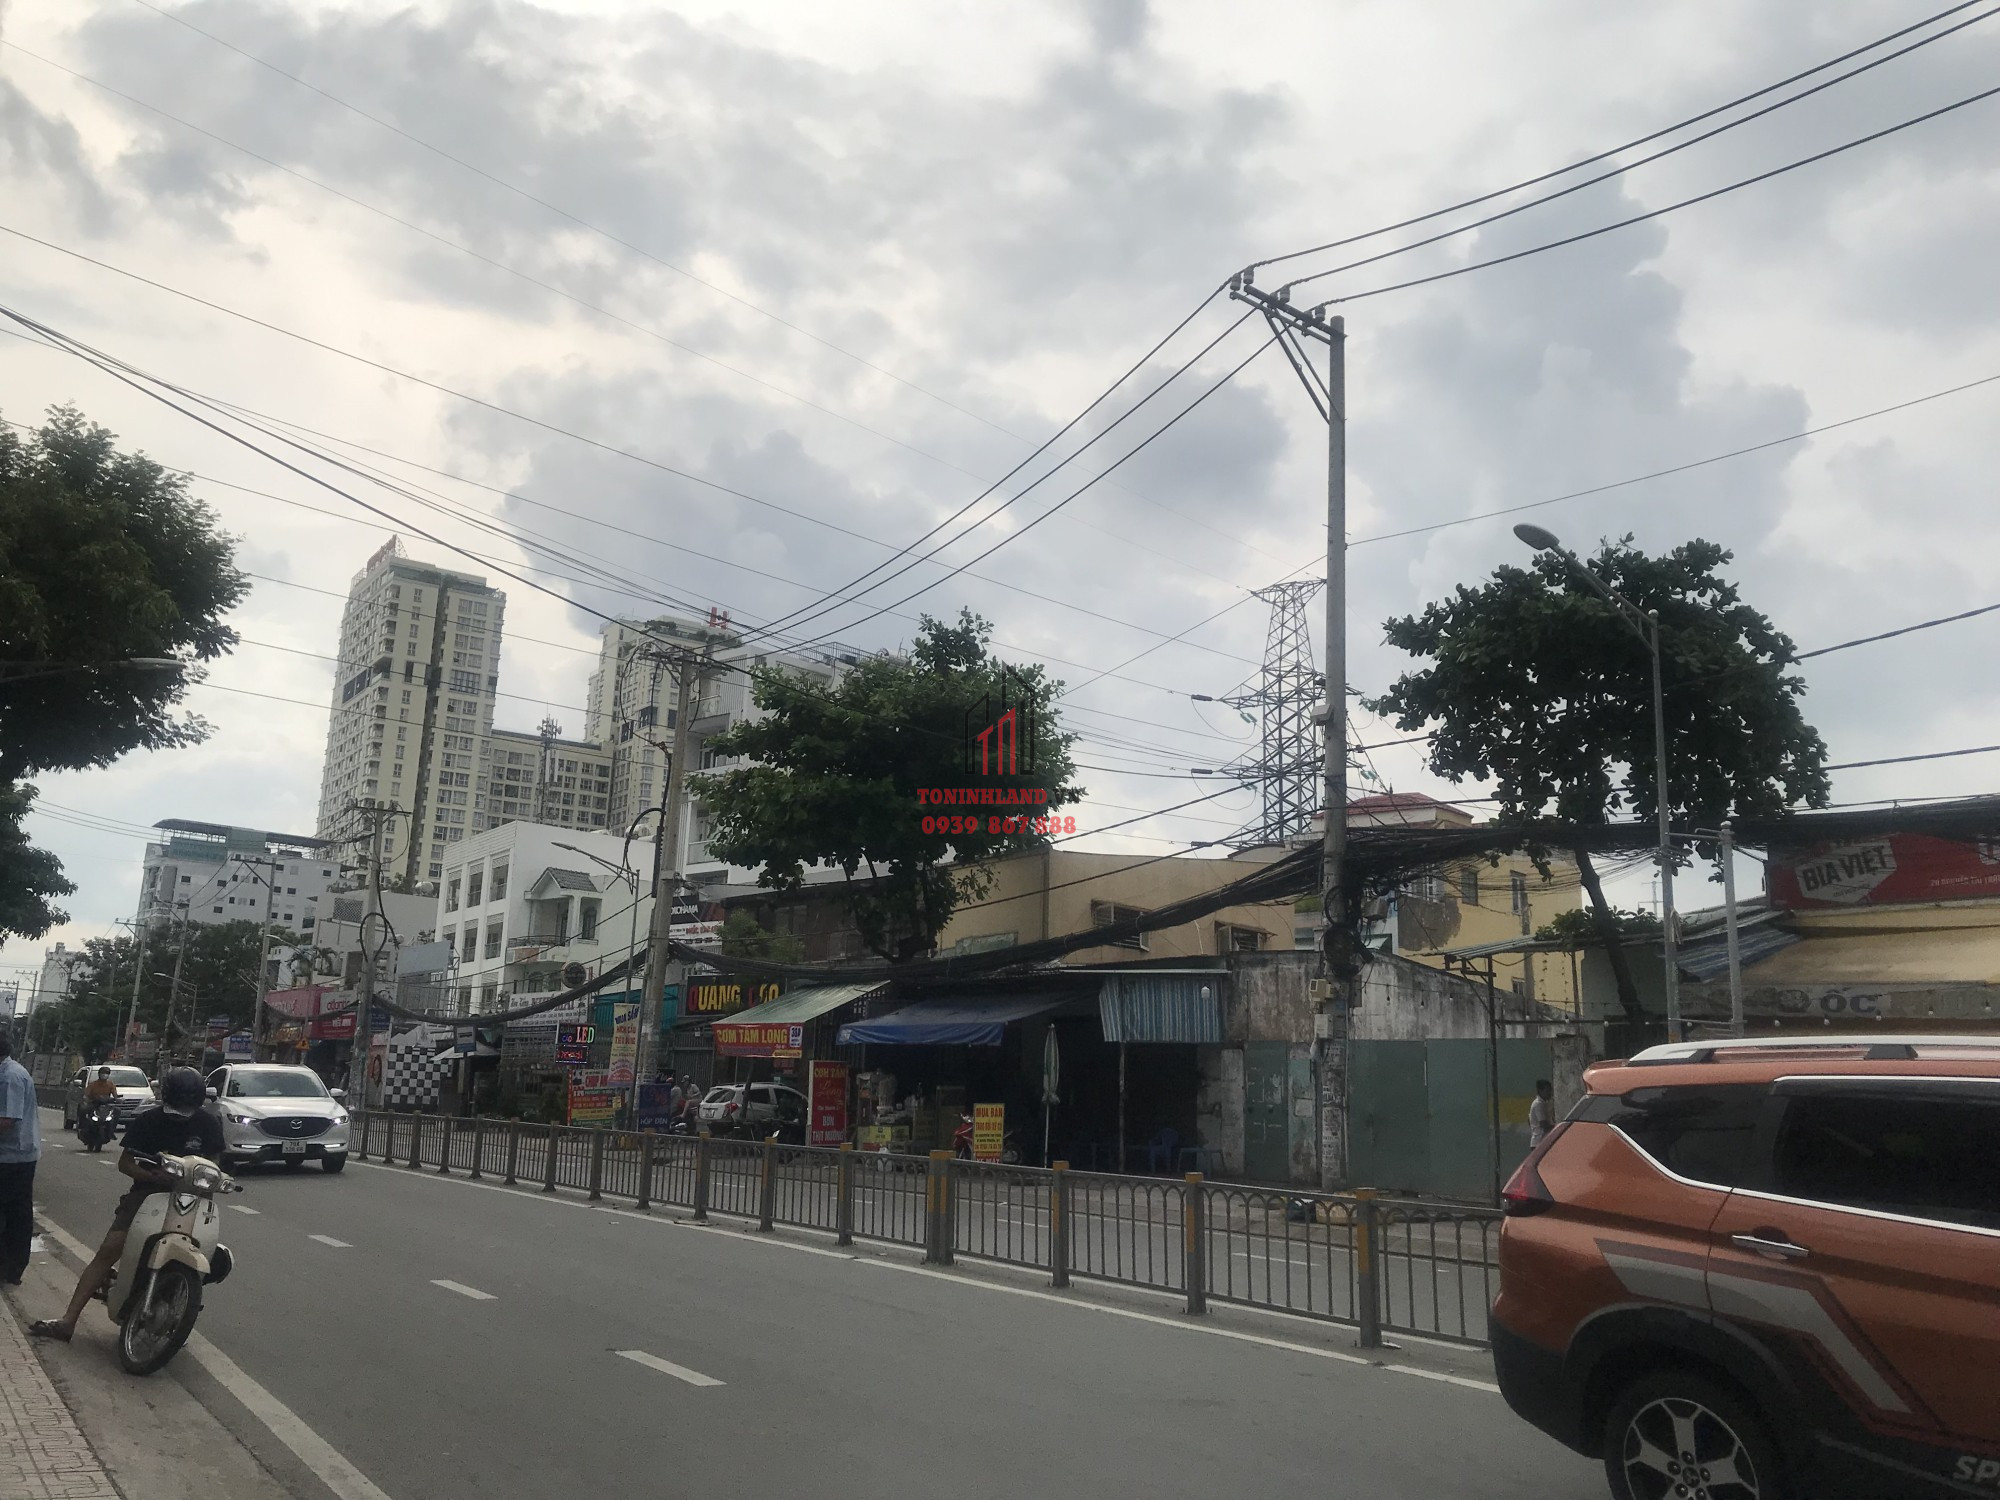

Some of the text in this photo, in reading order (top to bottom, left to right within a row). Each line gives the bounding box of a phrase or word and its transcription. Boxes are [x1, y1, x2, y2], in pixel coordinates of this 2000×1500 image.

[1802, 862, 1842, 891] BIA
[576, 1026, 595, 1043] LED
[761, 1029, 788, 1043] LONG
[1952, 1456, 2000, 1487] SP
